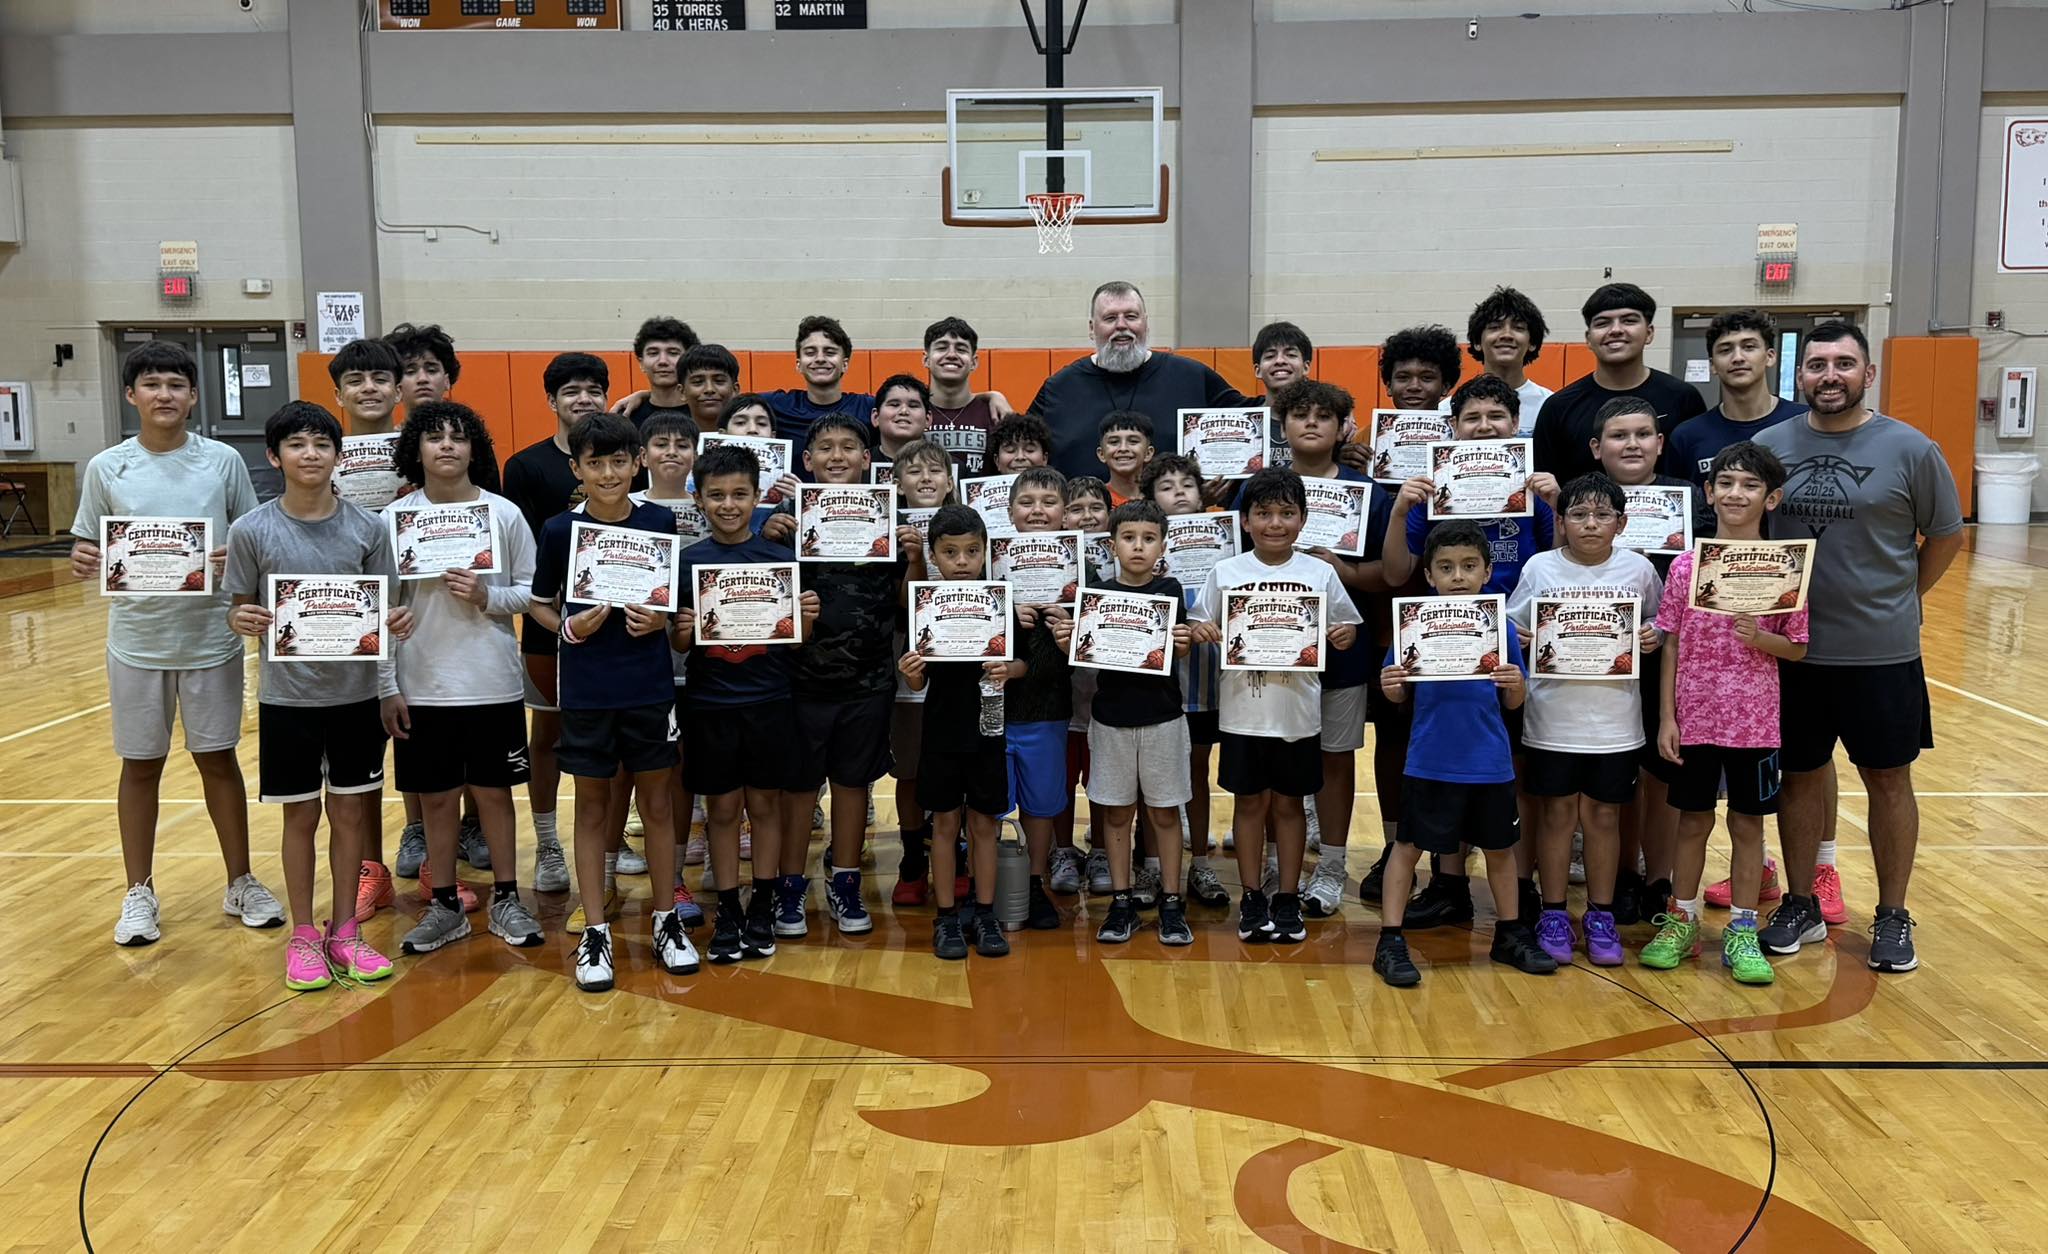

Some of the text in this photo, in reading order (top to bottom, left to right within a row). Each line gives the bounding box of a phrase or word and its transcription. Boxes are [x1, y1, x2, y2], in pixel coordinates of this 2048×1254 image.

[653, 4, 722, 16] 35 TORRES
[775, 3, 845, 16] 32 MARTIN
[399, 18, 421, 28] WON
[495, 17, 521, 28] GAME
[576, 17, 597, 28] WON
[654, 19, 729, 31] 40 K HERAS
[1765, 263, 1792, 281] EXIT
[327, 304, 360, 314] TEXAS
[1200, 419, 1250, 431] CERTIFICATE
[1395, 421, 1447, 434] CERTIFICATE
[930, 432, 985, 448] GGIES
[342, 447, 394, 459] ERTIFICATE
[1452, 452, 1510, 465] CERTIFICATE
[1305, 489, 1349, 504] RTIFICATE
[1804, 485, 1836, 497] 20 25
[820, 495, 875, 509] CERTIFICATE
[1781, 503, 1855, 520] BASKETBALL
[416, 514, 474, 529] CERTIFICATE
[128, 529, 189, 542] CERTIFICATE
[1168, 525, 1220, 539] CERTIFICATE
[598, 539, 656, 557] CERTIFICATE
[1009, 544, 1063, 557] CERTIFICATE
[1722, 552, 1788, 564] CERTIFICATE
[719, 576, 777, 590] CERTIFICATE
[298, 587, 363, 601] CERTIFICATE
[934, 593, 991, 606] CERTIFICATE
[1099, 603, 1154, 620] CERTIFICATE
[1247, 603, 1304, 616] CERTIFICATE
[1420, 609, 1481, 623] CERTIFICATE
[1557, 611, 1618, 624] CERTIFICATE
